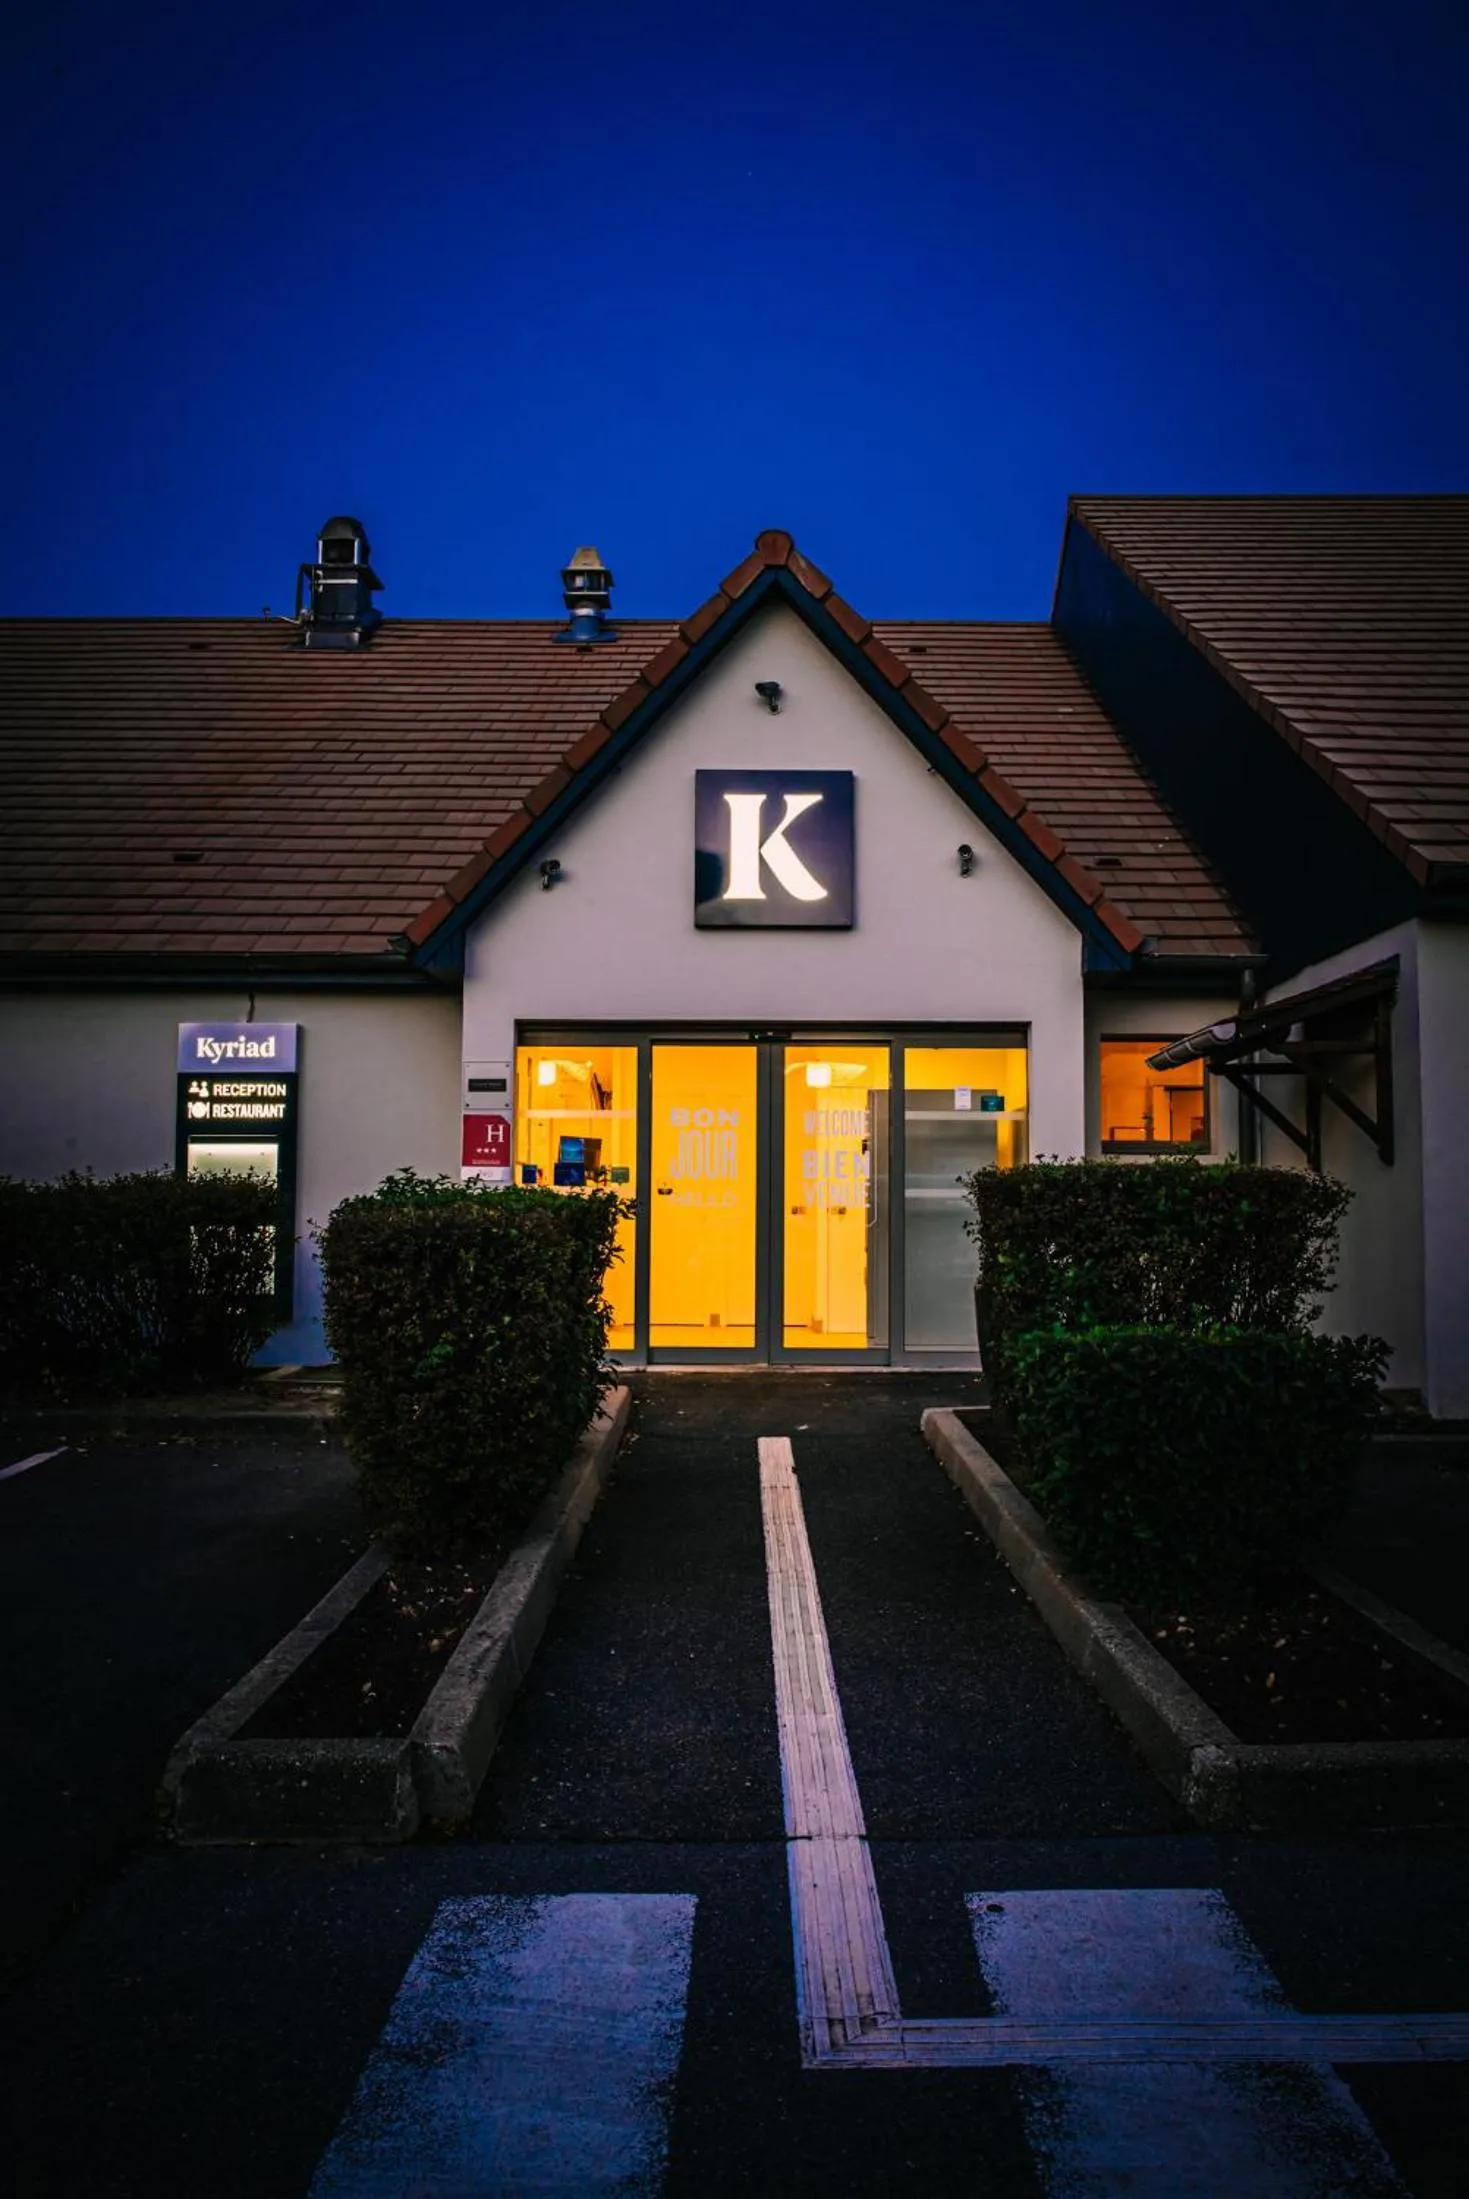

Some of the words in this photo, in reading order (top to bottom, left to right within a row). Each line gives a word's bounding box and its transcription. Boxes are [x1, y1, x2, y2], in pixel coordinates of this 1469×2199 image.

[723, 793, 829, 901] K
[196, 1035, 276, 1064] Kyriad
[213, 1083, 287, 1097] RECEPTION
[211, 1103, 287, 1119] RESTAURANT
[670, 1108, 739, 1128] BON
[803, 1110, 870, 1136] WELCOME
[485, 1123, 505, 1143] H
[669, 1129, 738, 1180] JOUR
[803, 1149, 871, 1179] BIEN
[803, 1181, 871, 1209] VENUE
